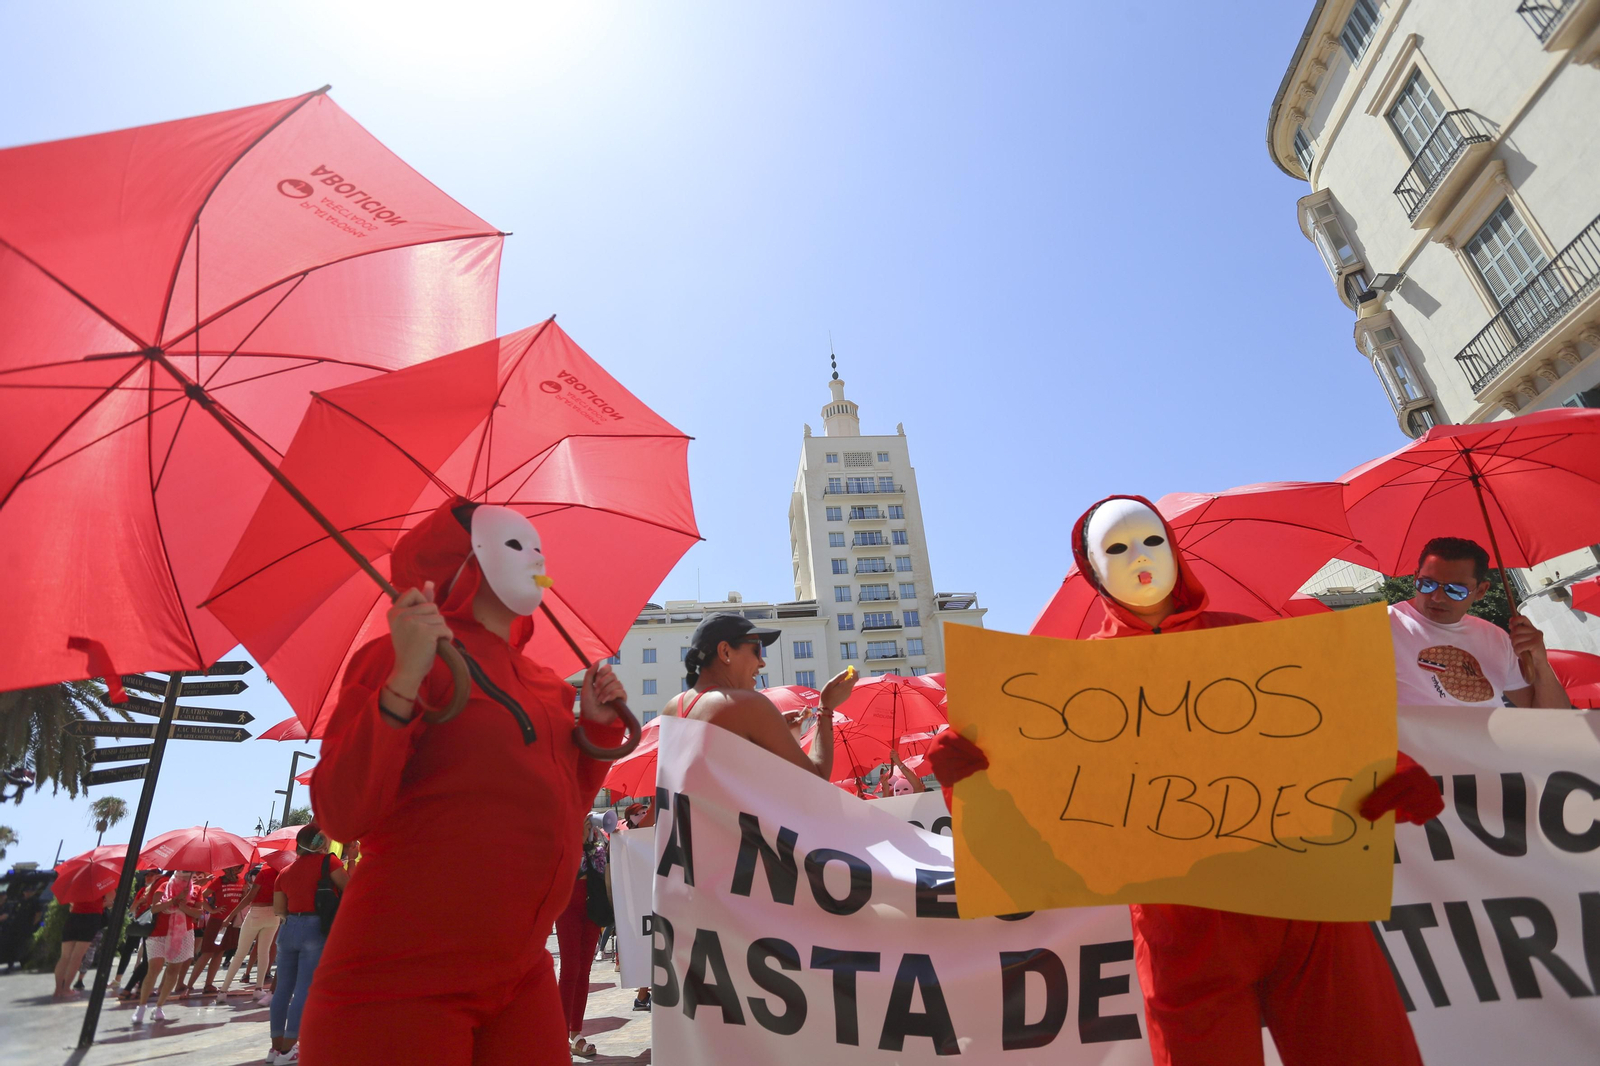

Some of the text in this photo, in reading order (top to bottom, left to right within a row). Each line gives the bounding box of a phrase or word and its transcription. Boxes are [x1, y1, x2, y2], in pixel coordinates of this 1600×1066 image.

[181, 707, 224, 717] TEATRO SOHO
[1001, 664, 1323, 743] SOMOS
[730, 811, 873, 916] NO
[1393, 770, 1600, 865] TUC
[651, 910, 962, 1056] BASTA
[999, 939, 1143, 1051] DE
